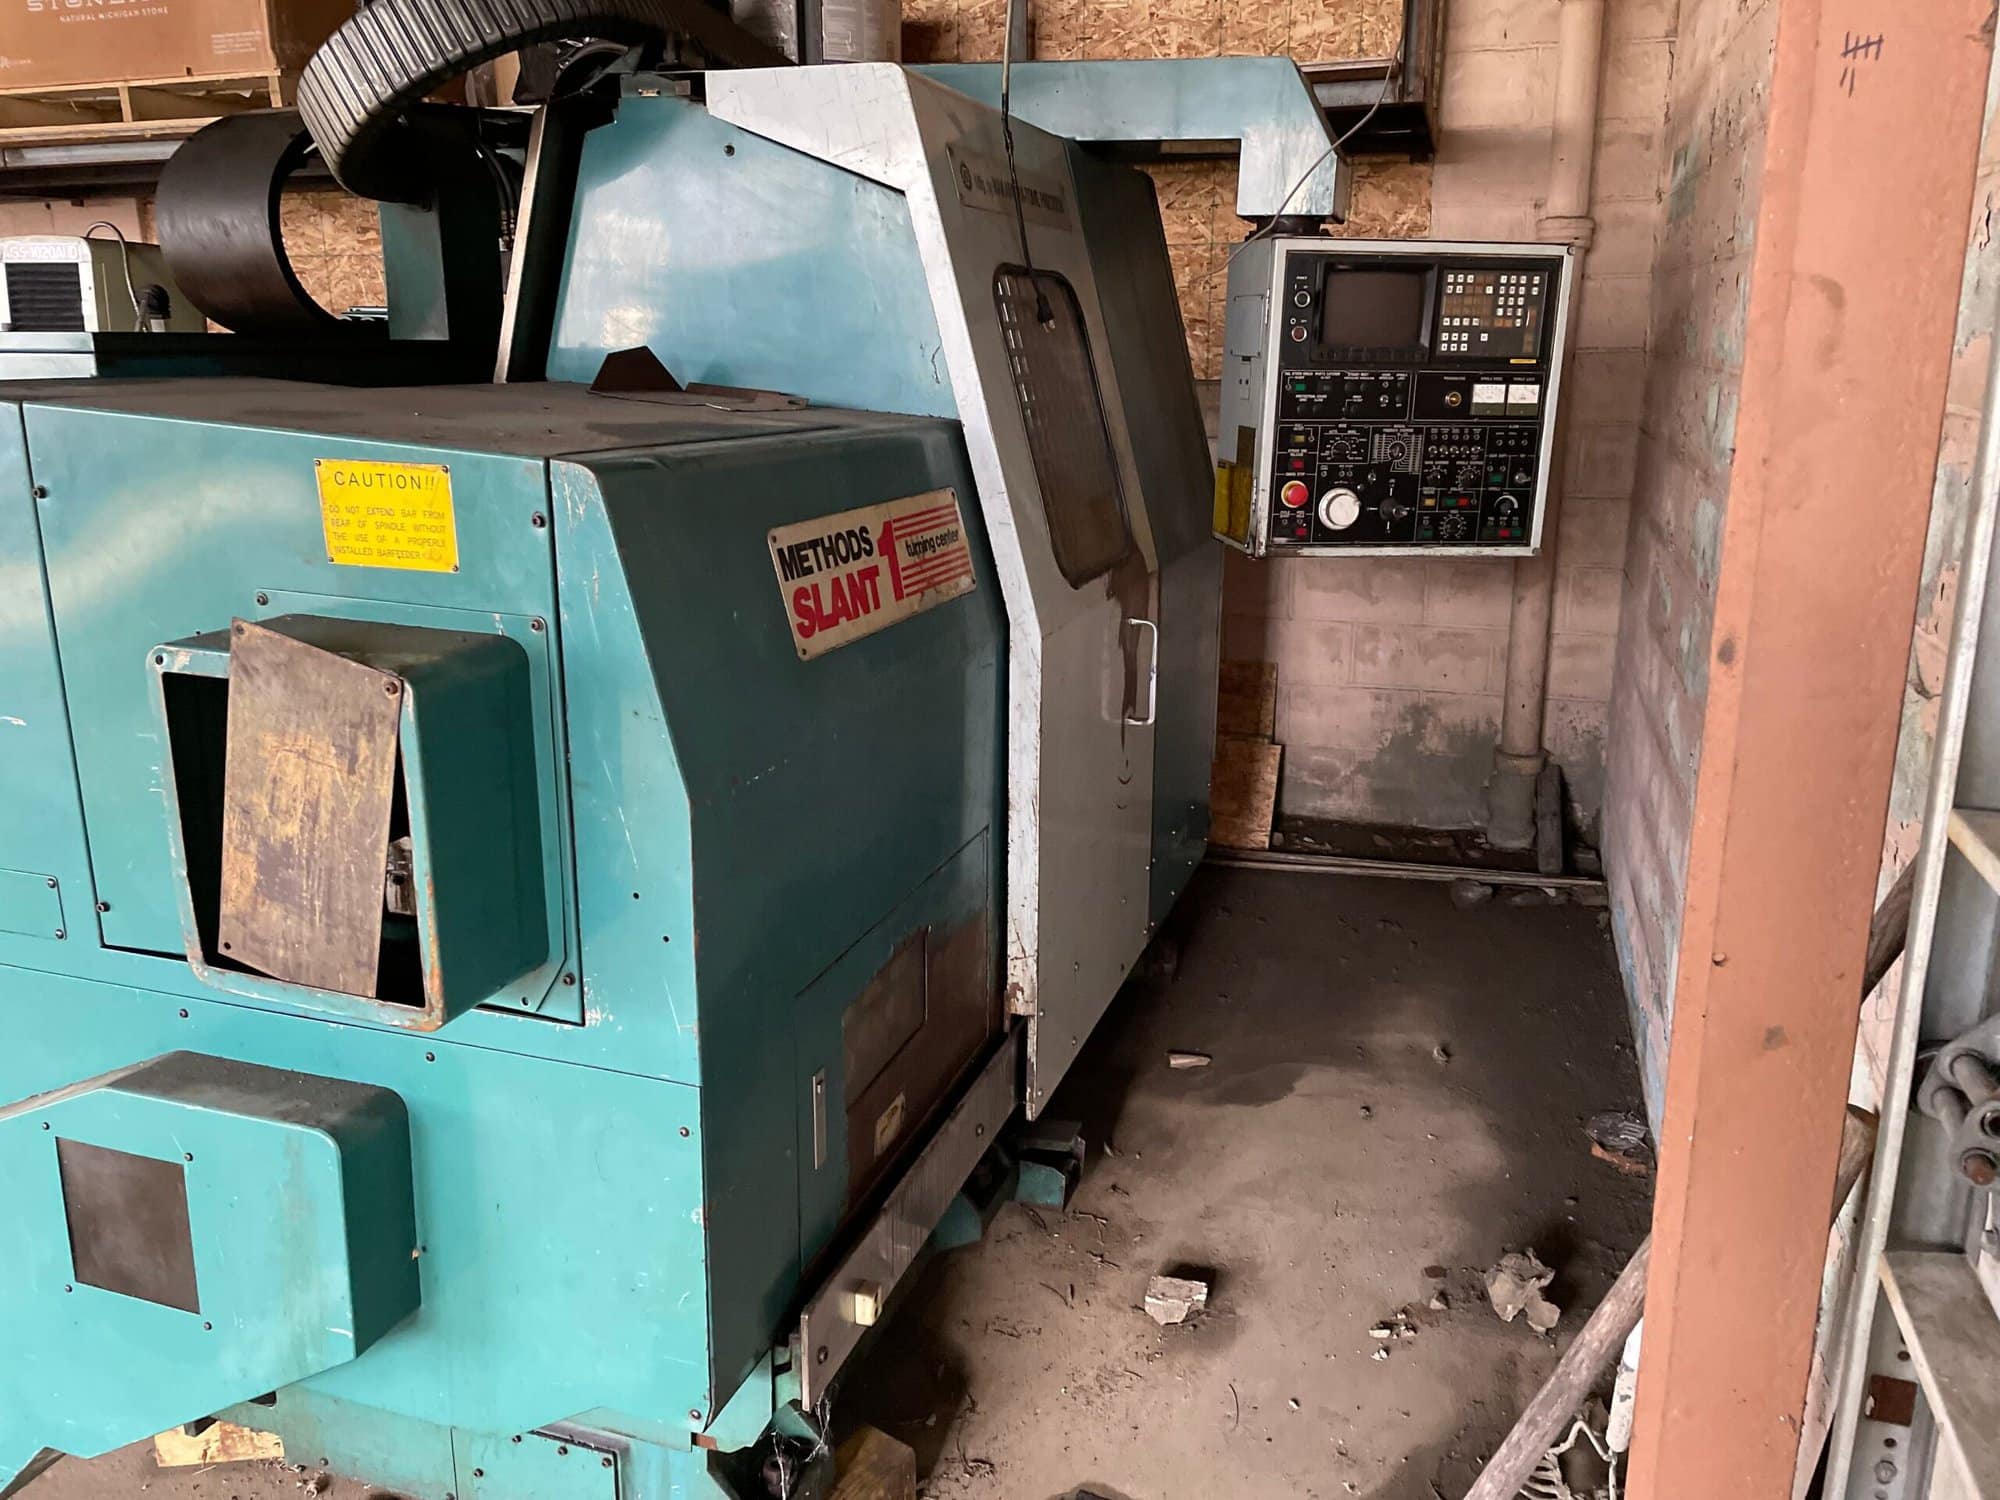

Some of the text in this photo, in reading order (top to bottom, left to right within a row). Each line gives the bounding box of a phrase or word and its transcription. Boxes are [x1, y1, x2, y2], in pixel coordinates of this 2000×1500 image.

[59, 6, 169, 22] NATURAL MICHIGAN STONE
[329, 504, 445, 520] DO NOT EXTEND BAR FROM
[331, 518, 446, 534] REAR OF SPINDLE WITHOUT
[333, 531, 348, 541] THE
[355, 533, 369, 543] USE
[376, 534, 386, 544] OF
[335, 545, 373, 556] INSTALLED
[777, 520, 960, 602] METHODS 1 turning center
[793, 565, 882, 639] SLANT
